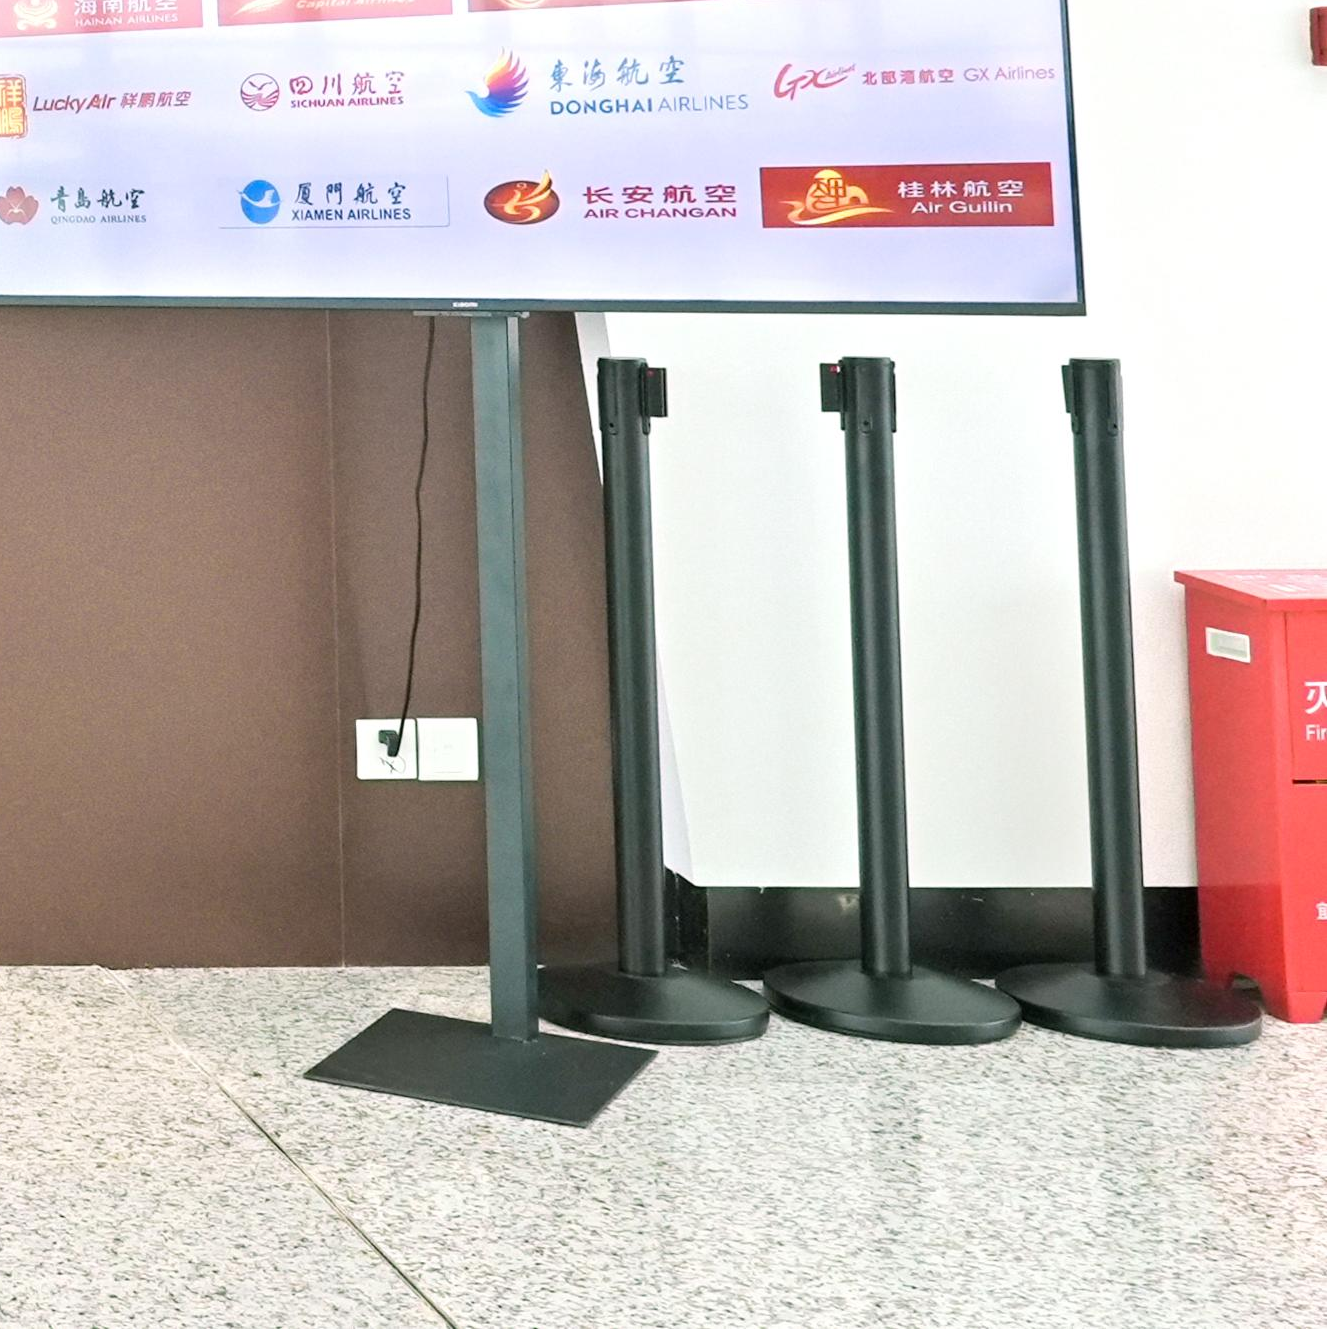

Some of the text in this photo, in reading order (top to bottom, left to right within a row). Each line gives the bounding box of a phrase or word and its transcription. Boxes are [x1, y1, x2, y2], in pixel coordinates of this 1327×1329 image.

[74, 13, 179, 28] HAINAN AIRLINES
[963, 67, 990, 82] GX
[994, 64, 1055, 81] Airlines
[289, 70, 405, 96] 四川航空
[290, 96, 405, 109] SICHUAN AIRLINES
[549, 93, 749, 116] DONGHAI AIRLINES
[582, 184, 737, 205] 长安航空
[897, 179, 1025, 199] 桂林航空
[583, 207, 737, 219] AIR CHANGAN
[910, 199, 1013, 214] Air Guilin
[50, 214, 147, 225] QINGDAO AIRLINES
[291, 207, 412, 222] XIAMEN AIRLINES
